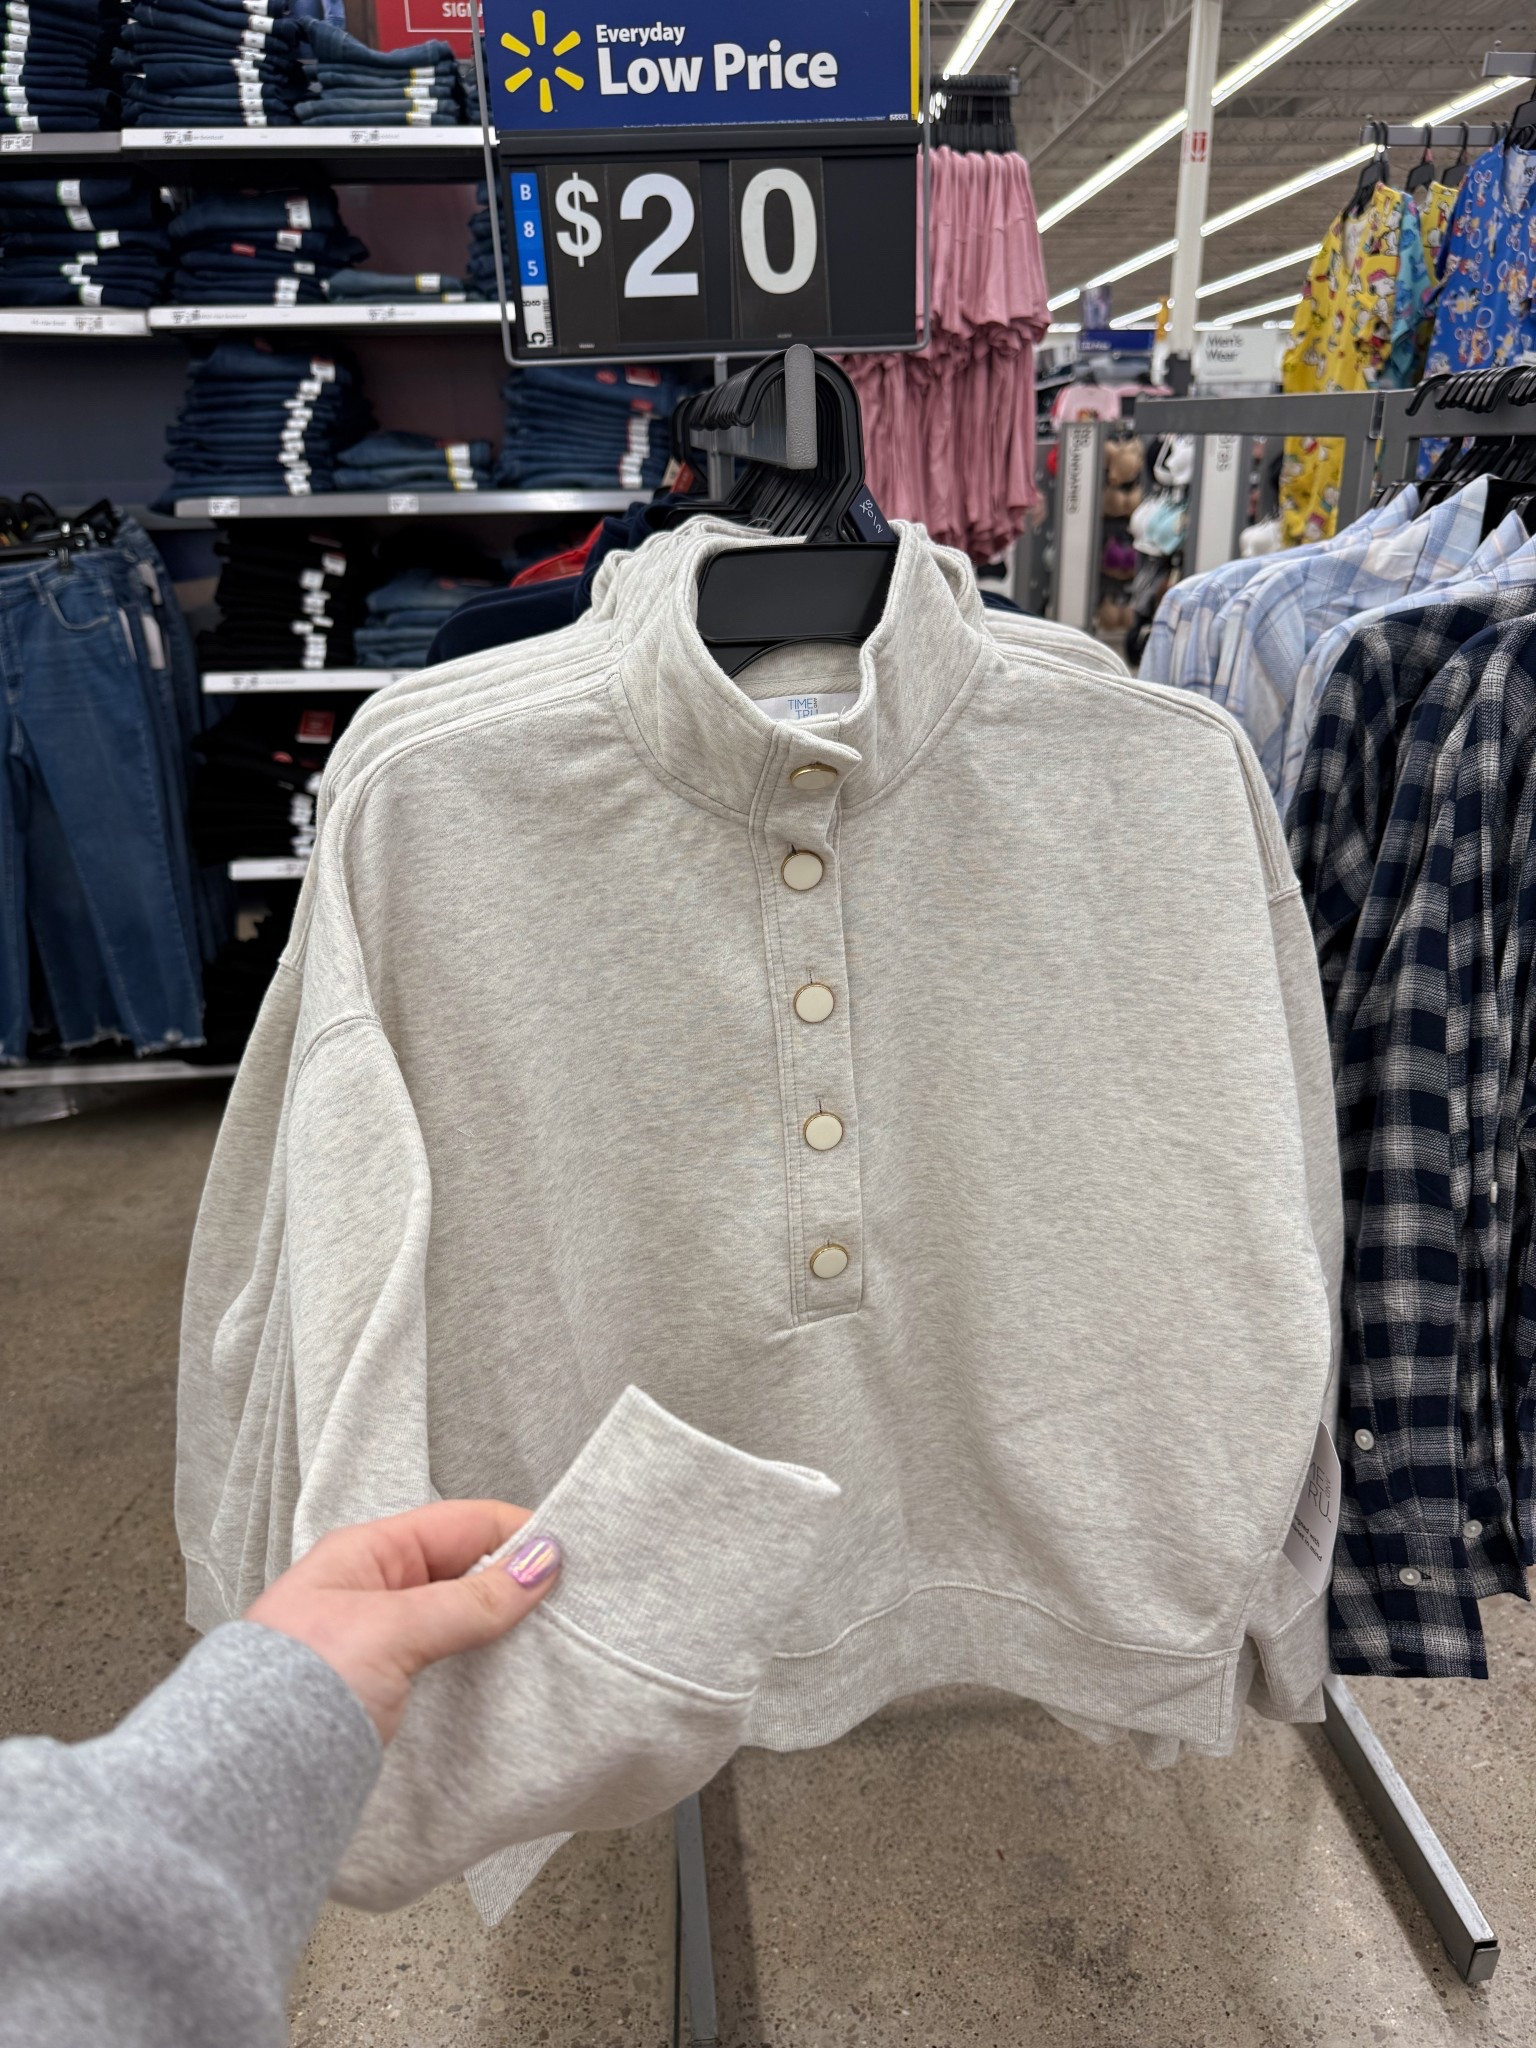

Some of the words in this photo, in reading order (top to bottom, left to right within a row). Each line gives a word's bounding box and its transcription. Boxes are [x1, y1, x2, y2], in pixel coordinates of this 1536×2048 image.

[596, 22, 686, 47] Everyday
[598, 47, 703, 95] Low
[713, 39, 839, 92] Price
[1205, 332, 1244, 348] Men's
[859, 499, 874, 514] XS
[787, 697, 813, 710] TIME
[1309, 1532, 1320, 1549] with
